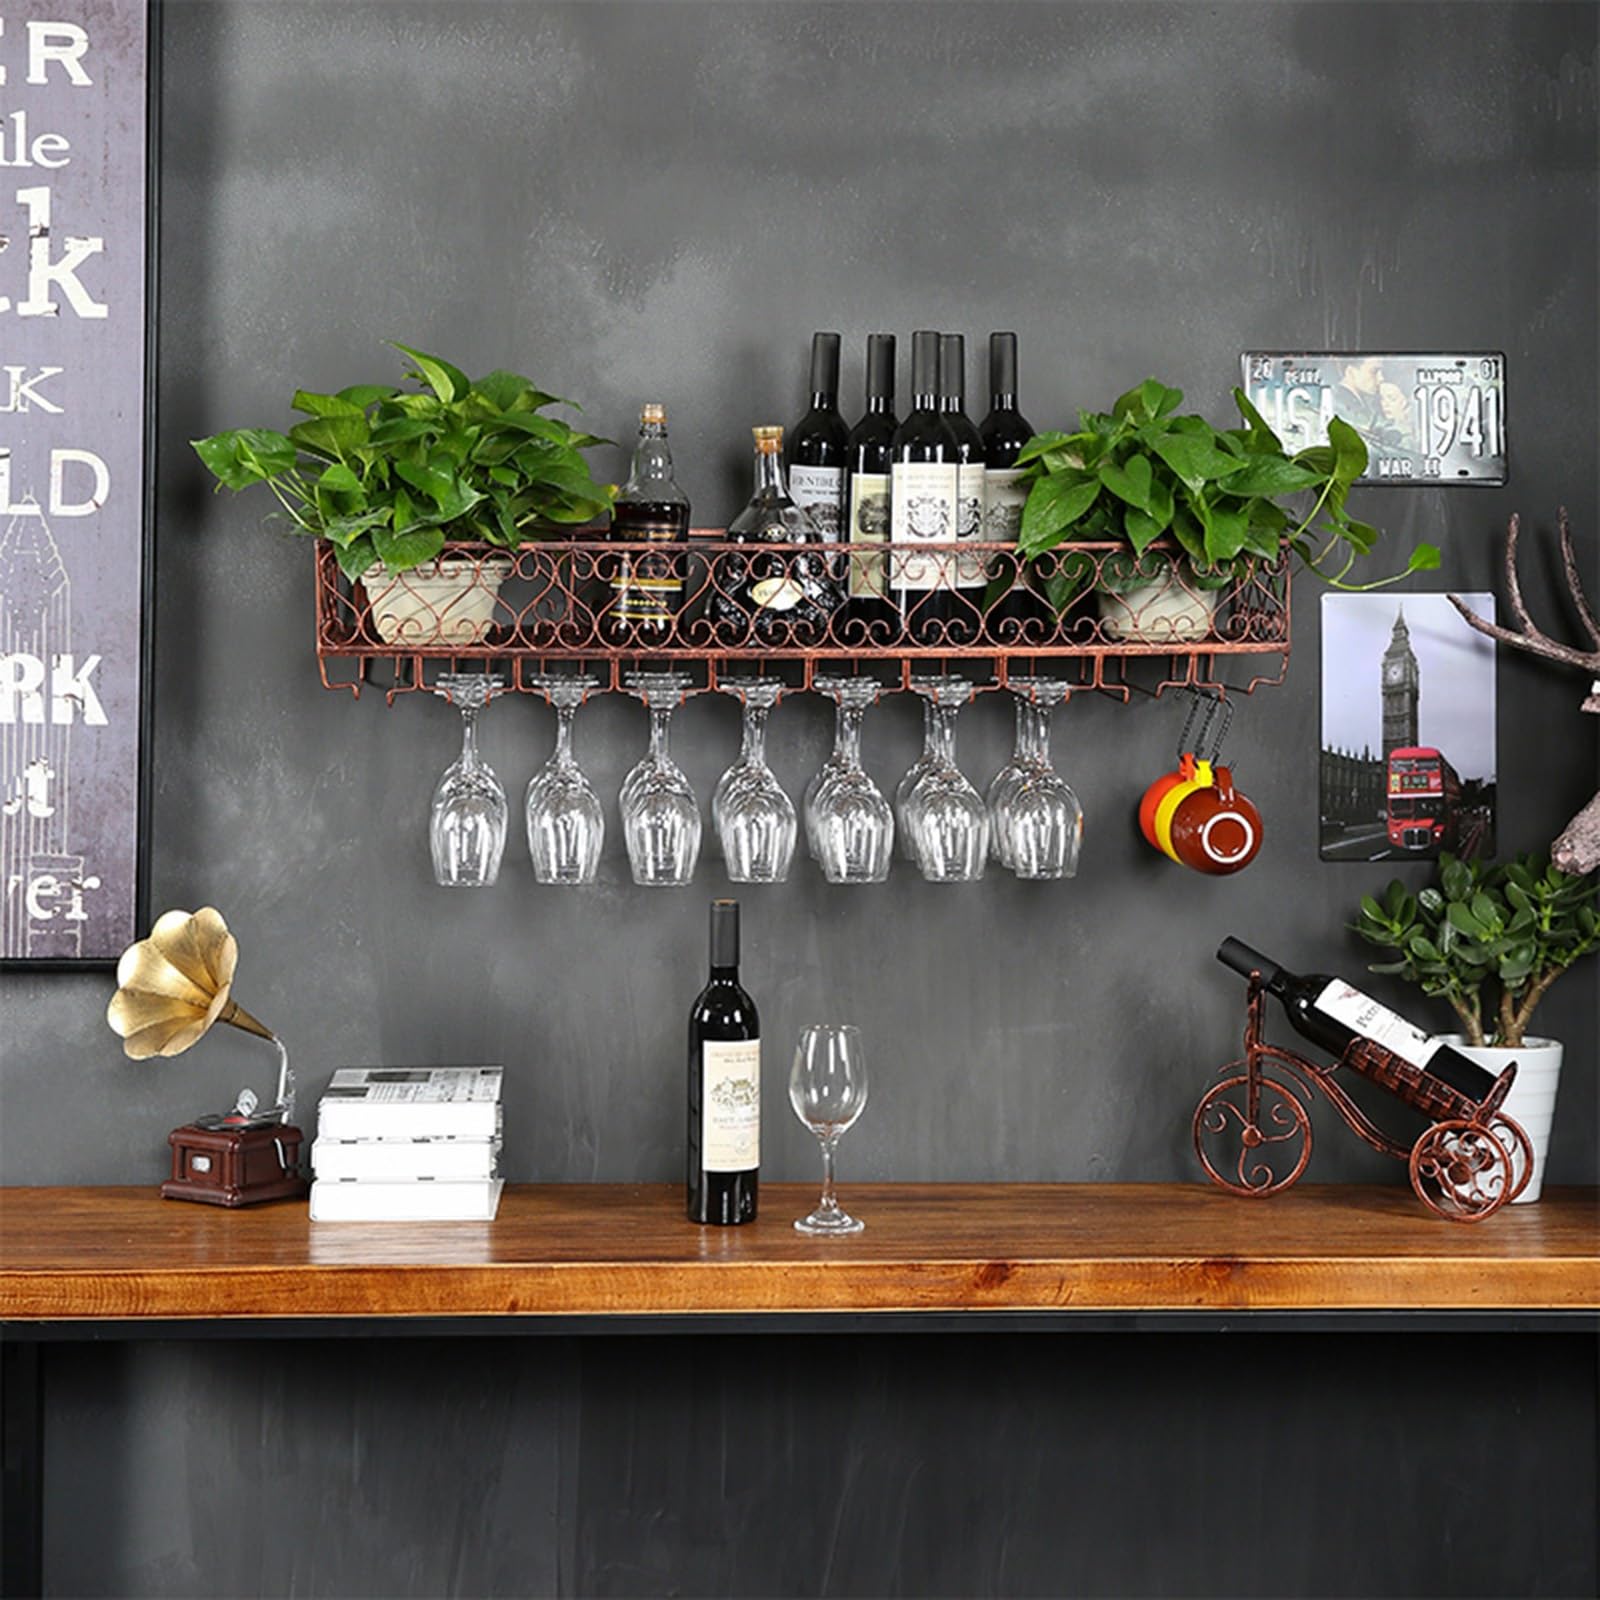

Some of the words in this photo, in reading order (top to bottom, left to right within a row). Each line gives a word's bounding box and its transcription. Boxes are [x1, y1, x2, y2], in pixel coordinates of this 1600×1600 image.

[0, 17, 94, 86] R
[0, 186, 109, 318] k
[0, 366, 65, 413] K
[1414, 385, 1499, 458] 1941
[1378, 457, 1413, 478] WAR
